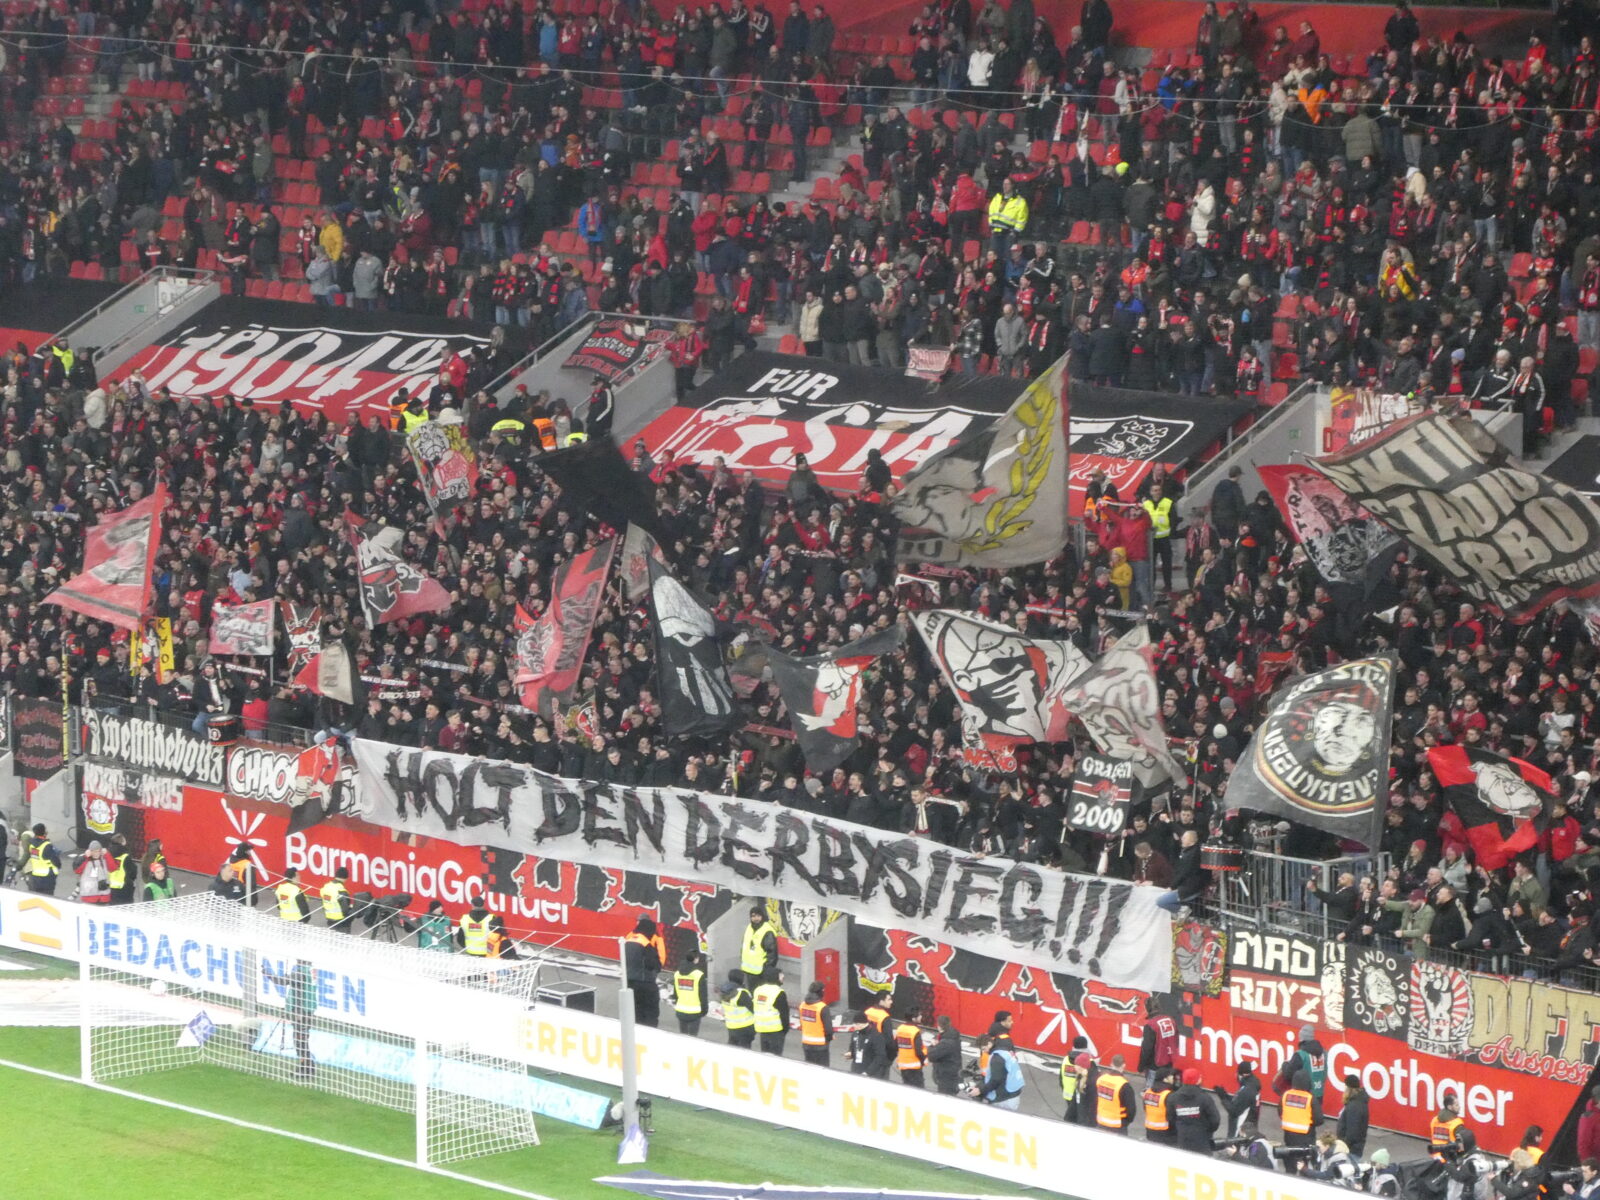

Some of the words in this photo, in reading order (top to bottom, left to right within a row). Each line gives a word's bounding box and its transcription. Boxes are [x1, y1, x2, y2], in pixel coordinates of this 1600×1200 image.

[747, 368, 839, 399] FÜR
[385, 748, 534, 837] HOLT
[534, 774, 667, 864] DEN
[1071, 801, 1124, 832] 2009
[1233, 931, 1316, 976] MAD
[1230, 976, 1322, 1023] BOYZ
[1349, 950, 1398, 1025] COMMANDO
[1395, 972, 1409, 1016] 1989
[687, 1055, 800, 1112] KLEVE
[842, 1091, 1038, 1170] NIJMEGEN
